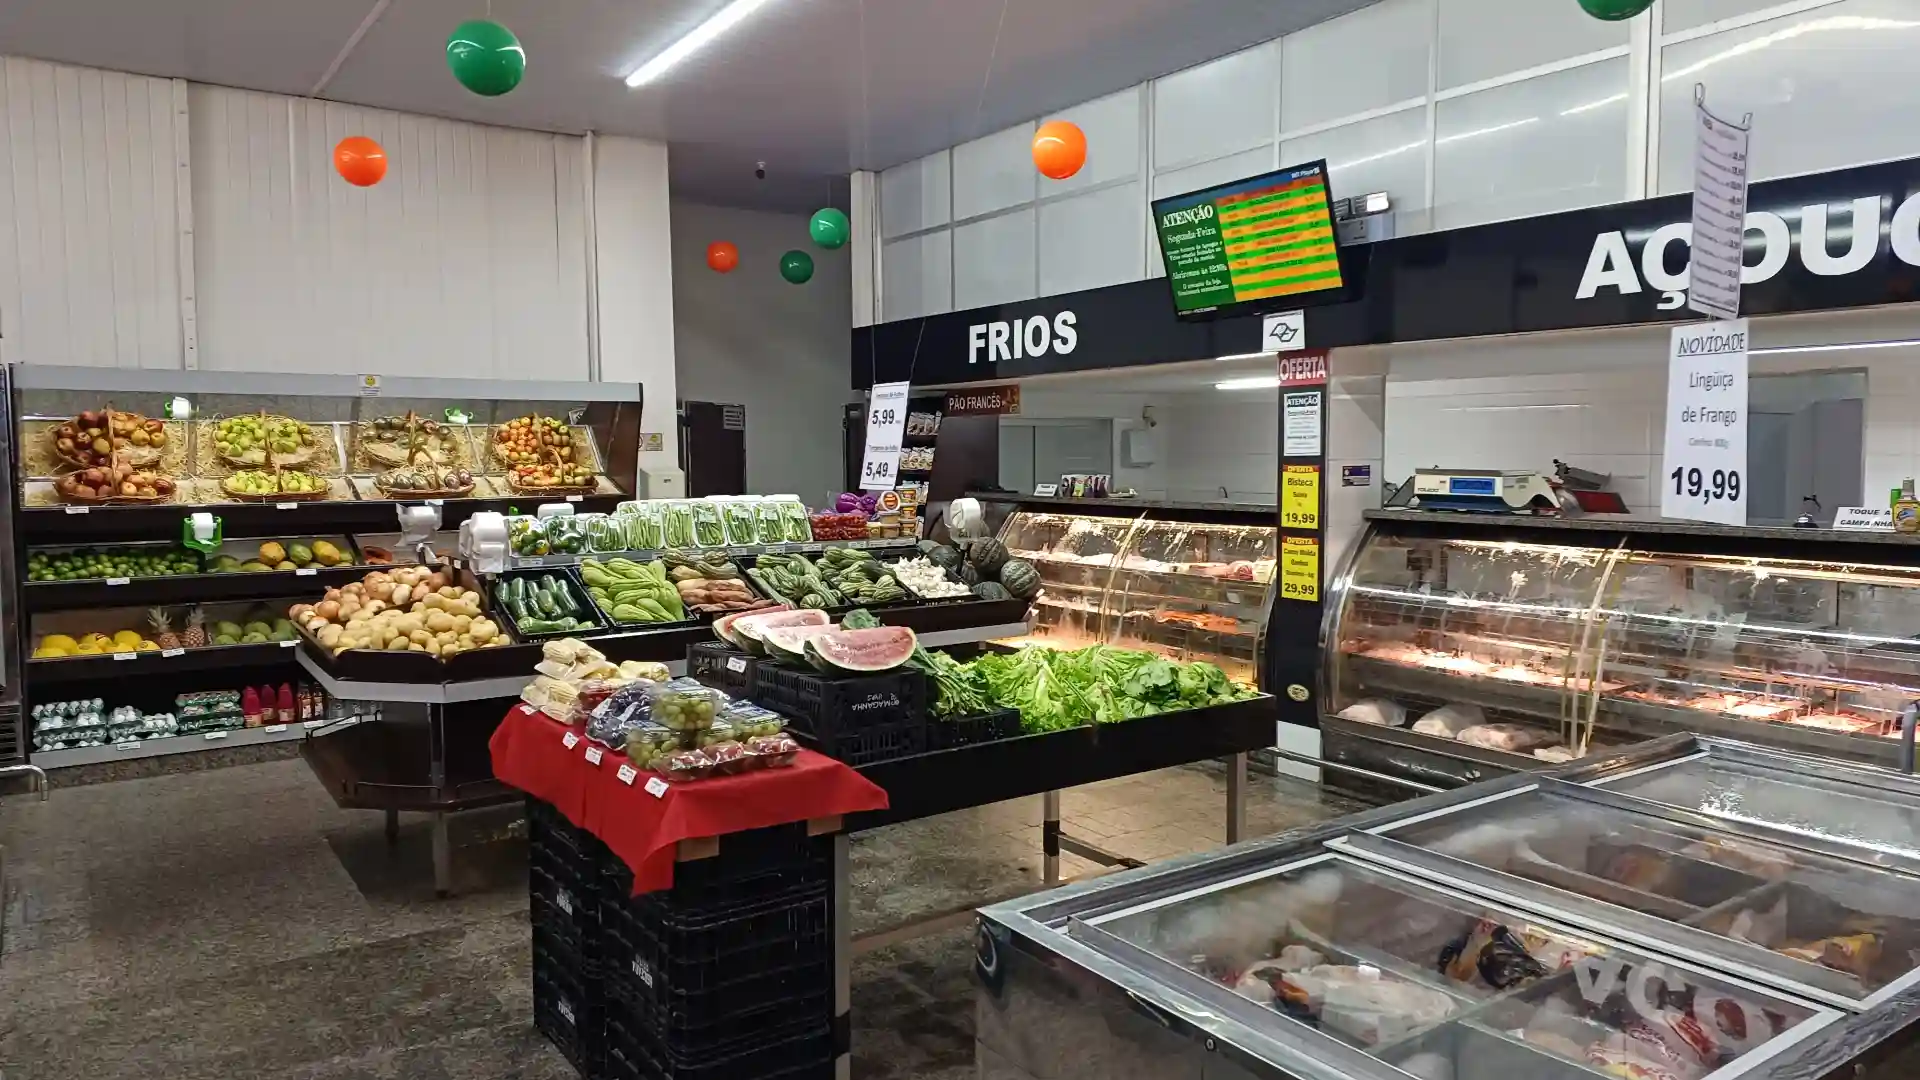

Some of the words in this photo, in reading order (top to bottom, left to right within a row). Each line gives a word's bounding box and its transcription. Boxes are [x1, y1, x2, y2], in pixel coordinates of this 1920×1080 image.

[1163, 204, 1214, 229] ATENÇÃO
[968, 310, 1078, 364] FRIOS
[1678, 333, 1745, 355] NOVIDADE
[1280, 355, 1326, 381] OFERTA
[949, 394, 966, 411] PÃO
[966, 391, 1001, 410] FRANCÊS
[1287, 395, 1318, 406] ATENÇÃO
[872, 409, 895, 428] 5,99
[1682, 406, 1697, 423] de
[1700, 407, 1737, 427] Frango
[866, 462, 888, 480] 5,49
[1287, 478, 1313, 487] Bisteca
[1671, 467, 1740, 504] 19,99
[1285, 513, 1316, 525] 19,99
[1849, 508, 1880, 516] TOQUE
[1284, 583, 1315, 596] 29,99
